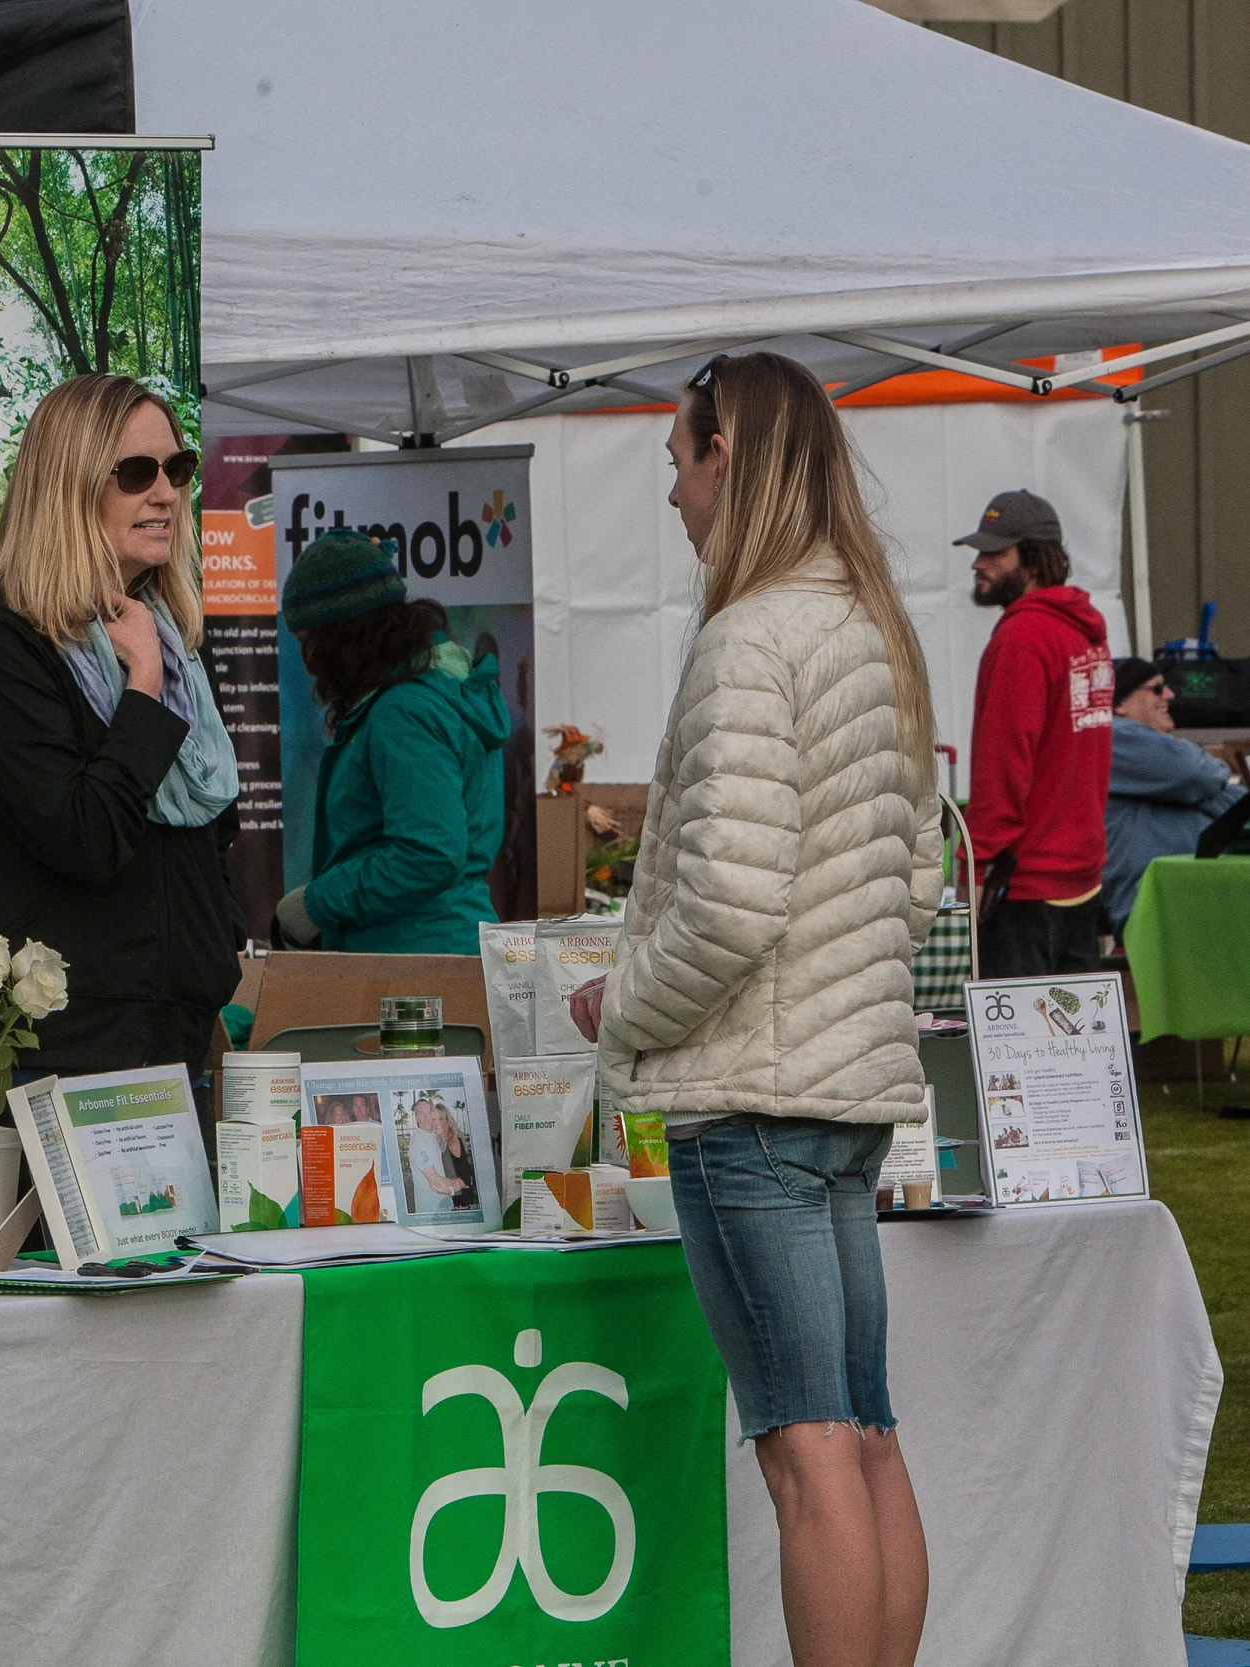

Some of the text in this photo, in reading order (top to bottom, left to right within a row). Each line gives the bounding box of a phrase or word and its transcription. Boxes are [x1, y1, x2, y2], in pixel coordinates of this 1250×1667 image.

[202, 530, 235, 545] OW
[559, 937, 611, 947] ARBONNE
[986, 1023, 1018, 1031] ARBONNE
[988, 1039, 1115, 1066] 30 Days to Healthy Living
[514, 1071, 548, 1081] ARBONNE
[307, 1080, 336, 1090] Change
[338, 1080, 354, 1088] your
[356, 1077, 368, 1087] life
[371, 1077, 388, 1086] with
[389, 1075, 422, 1086] Arbonne
[78, 1089, 172, 1111] Arbonne Fit Essentials
[515, 1114, 531, 1122] DAILY
[515, 1121, 555, 1130] FIBER BOOST
[117, 1237, 128, 1246] Just
[131, 1234, 144, 1244] what
[145, 1233, 160, 1242] every
[162, 1229, 178, 1239] BODY
